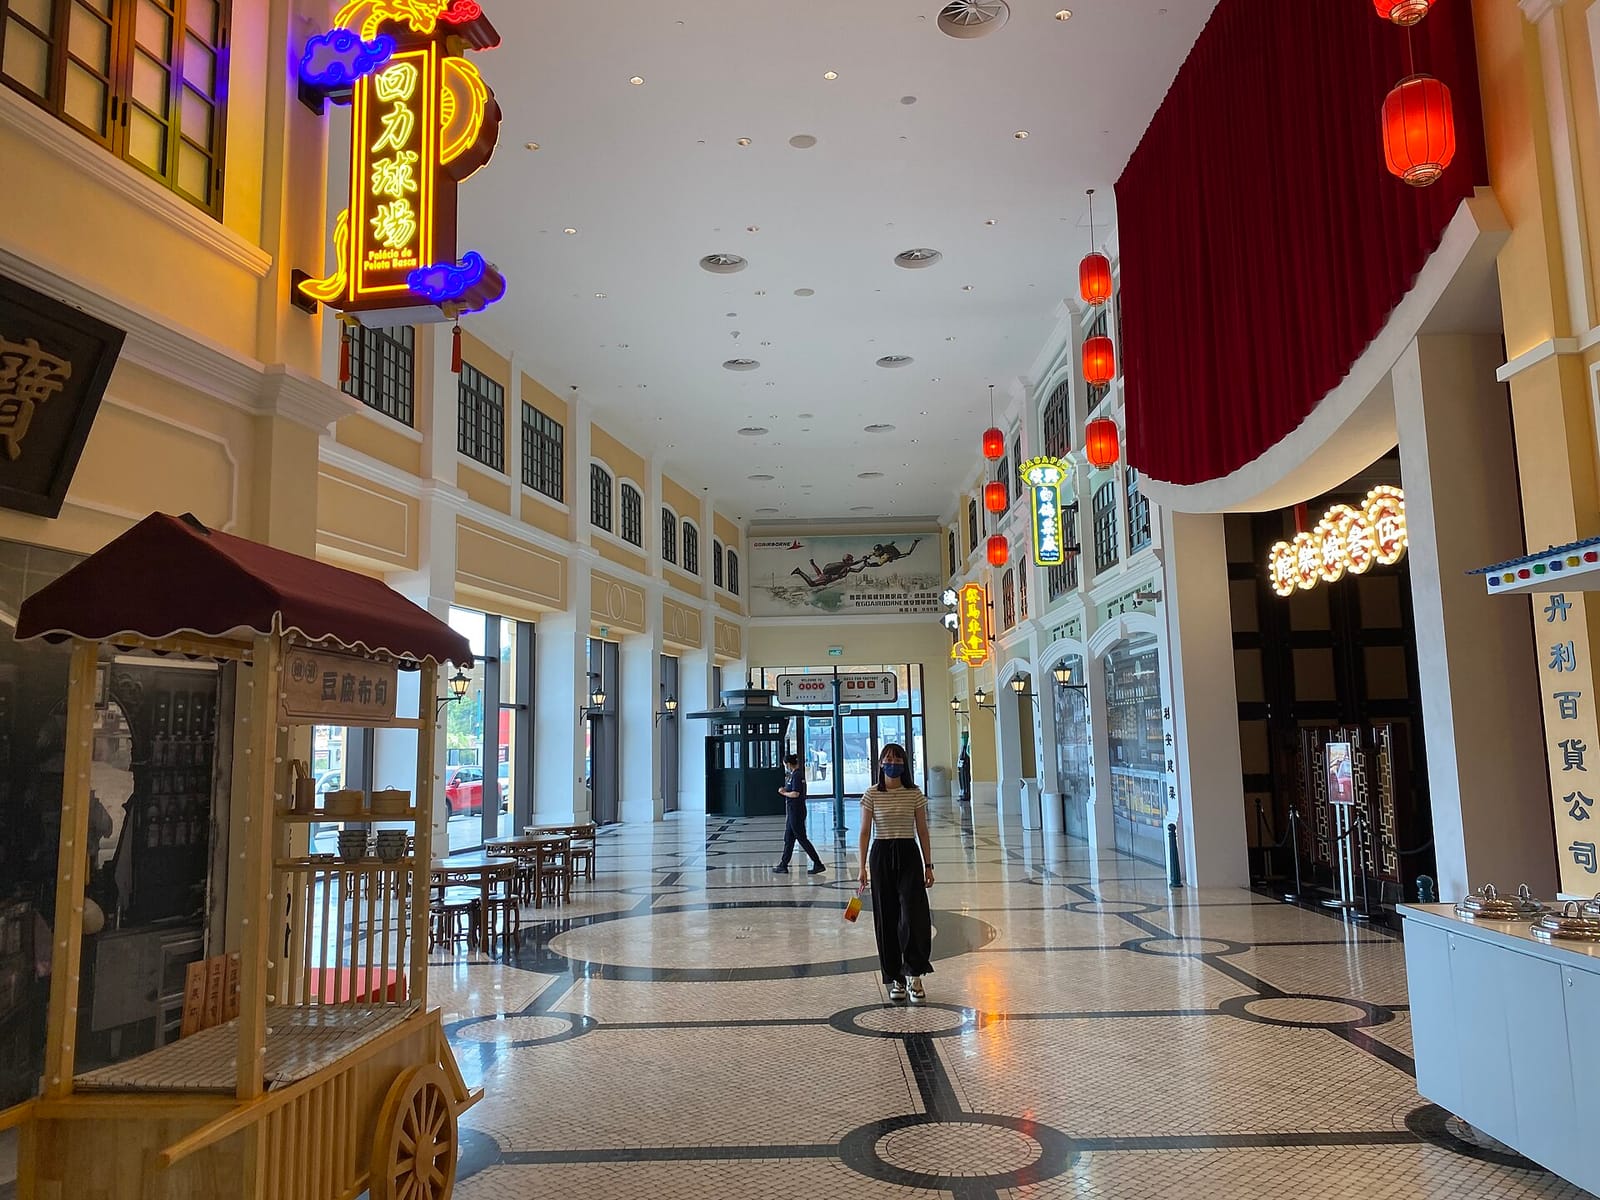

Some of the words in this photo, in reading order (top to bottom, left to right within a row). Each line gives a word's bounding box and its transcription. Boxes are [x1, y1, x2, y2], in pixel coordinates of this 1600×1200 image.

[371, 62, 418, 249] 回力球場
[369, 249, 399, 260] Palácio
[401, 247, 412, 258] de
[364, 260, 390, 270] Pelota
[392, 258, 417, 268] Basca
